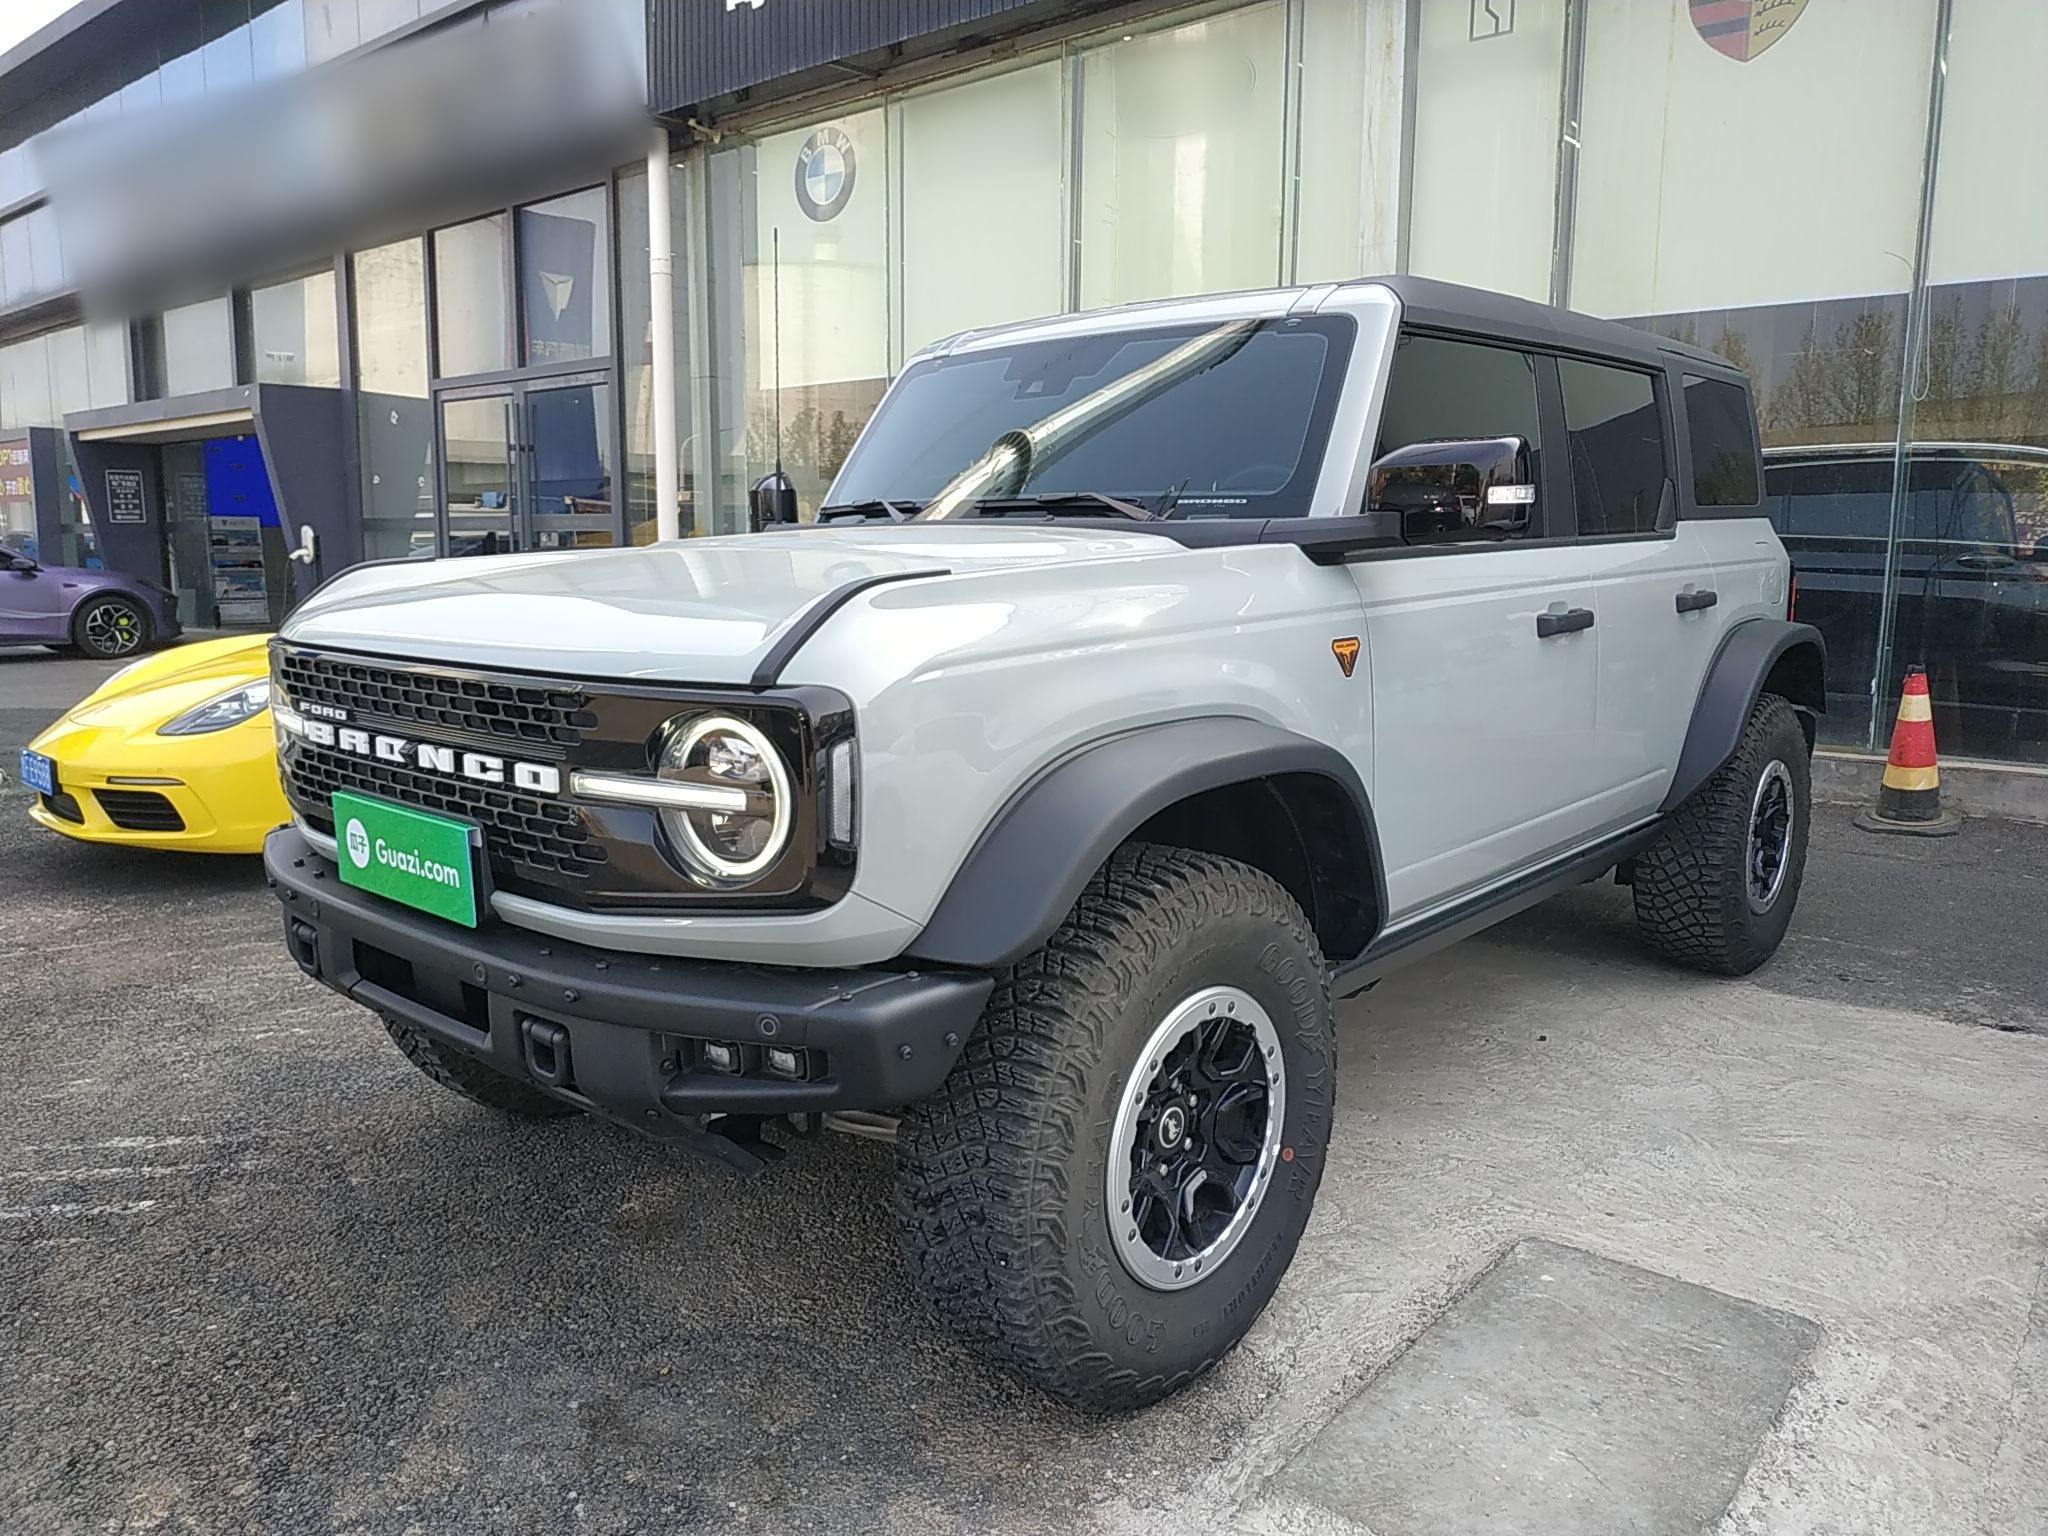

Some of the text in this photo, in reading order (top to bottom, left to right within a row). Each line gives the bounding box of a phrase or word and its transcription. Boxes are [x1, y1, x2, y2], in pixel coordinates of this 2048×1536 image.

[799, 128, 851, 165] BMW
[299, 701, 347, 720] FORD
[304, 719, 560, 794] BRONCO
[375, 838, 460, 888] Guazi.com
[1257, 942, 1328, 1201] GOODYEAR
